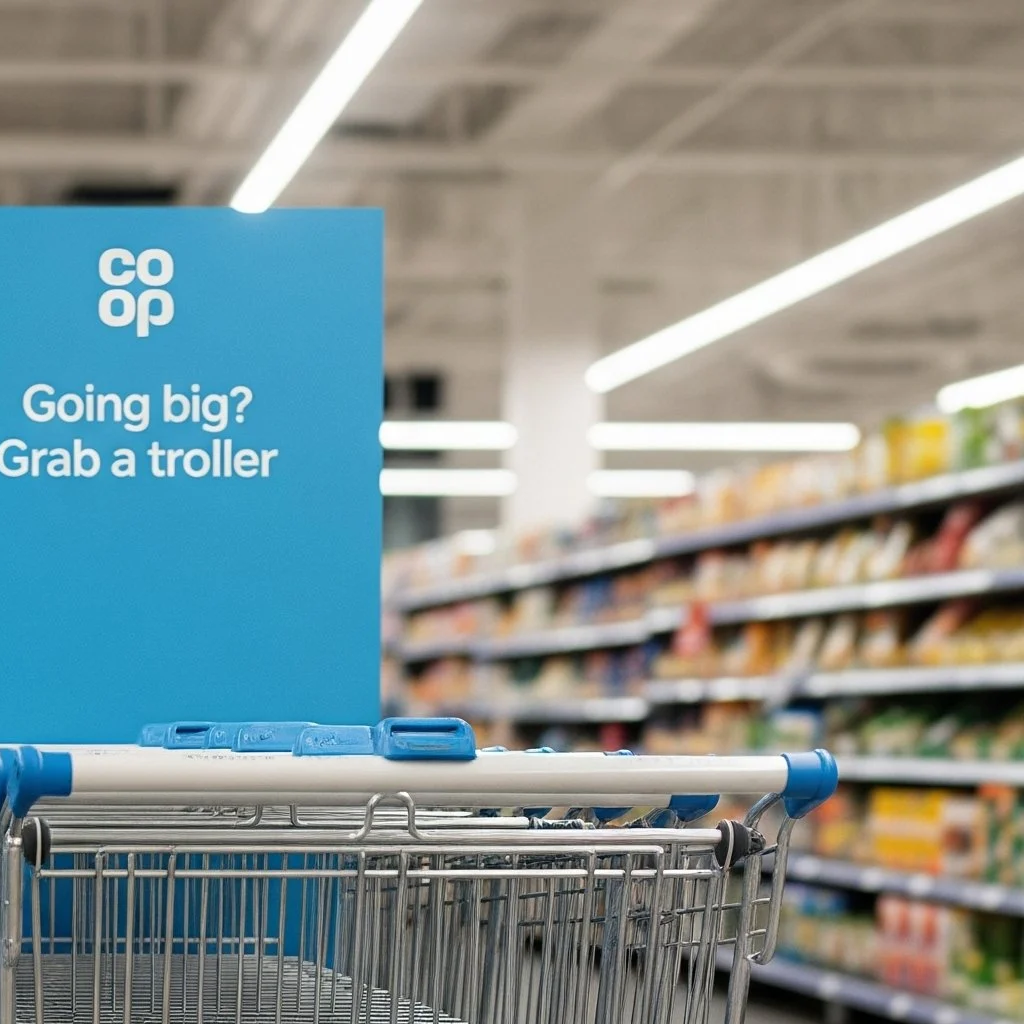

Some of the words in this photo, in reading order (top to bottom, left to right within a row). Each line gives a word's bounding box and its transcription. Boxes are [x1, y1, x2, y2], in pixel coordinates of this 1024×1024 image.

[22, 383, 150, 433] Going
[163, 383, 254, 433] big?
[110, 448, 136, 478] a
[147, 438, 279, 478] troller
